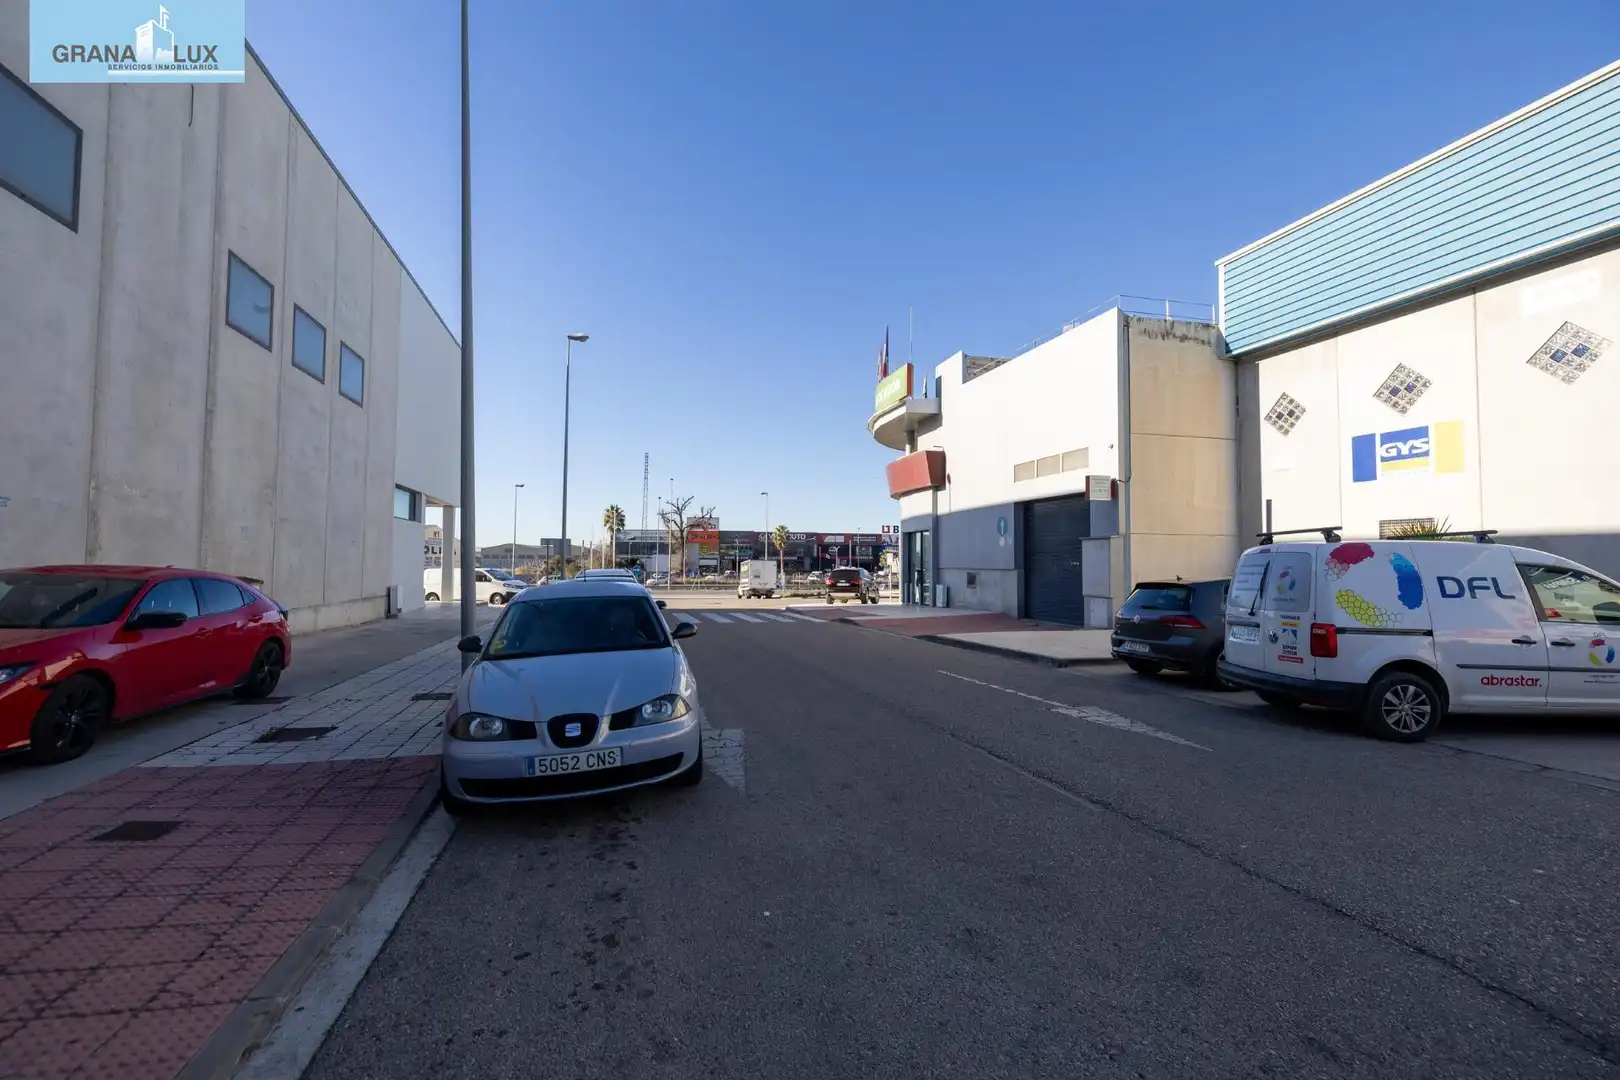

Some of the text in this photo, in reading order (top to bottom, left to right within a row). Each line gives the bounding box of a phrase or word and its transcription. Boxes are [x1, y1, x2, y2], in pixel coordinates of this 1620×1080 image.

[1380, 437, 1430, 457] GYS
[1436, 575, 1516, 600] DFL
[538, 750, 617, 774] 5052 CNS
